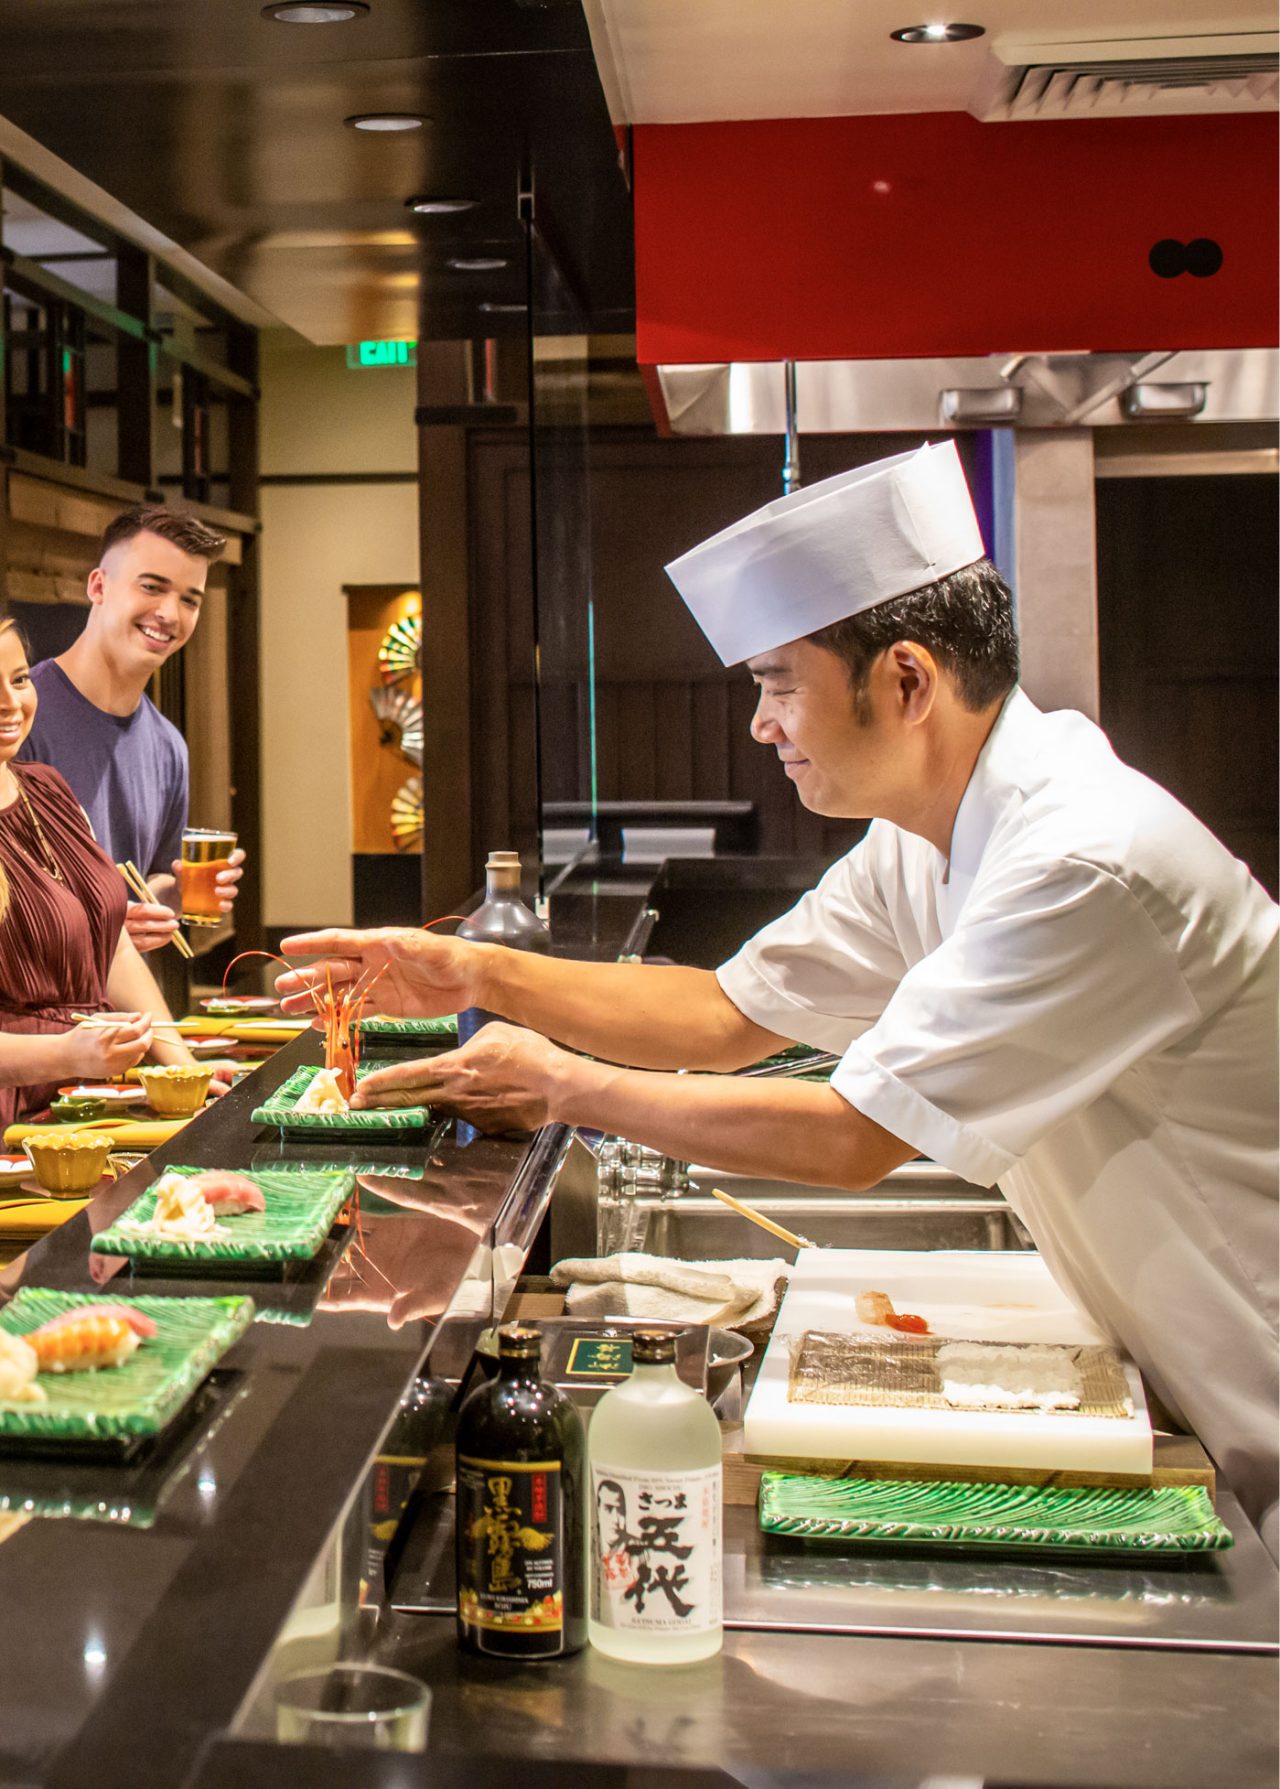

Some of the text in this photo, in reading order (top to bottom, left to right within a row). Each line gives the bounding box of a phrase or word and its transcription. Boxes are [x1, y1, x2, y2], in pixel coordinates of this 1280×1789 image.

[638, 1491, 688, 1511] さつま
[624, 1516, 695, 1618] 五代
[527, 1578, 554, 1589] 750ml
